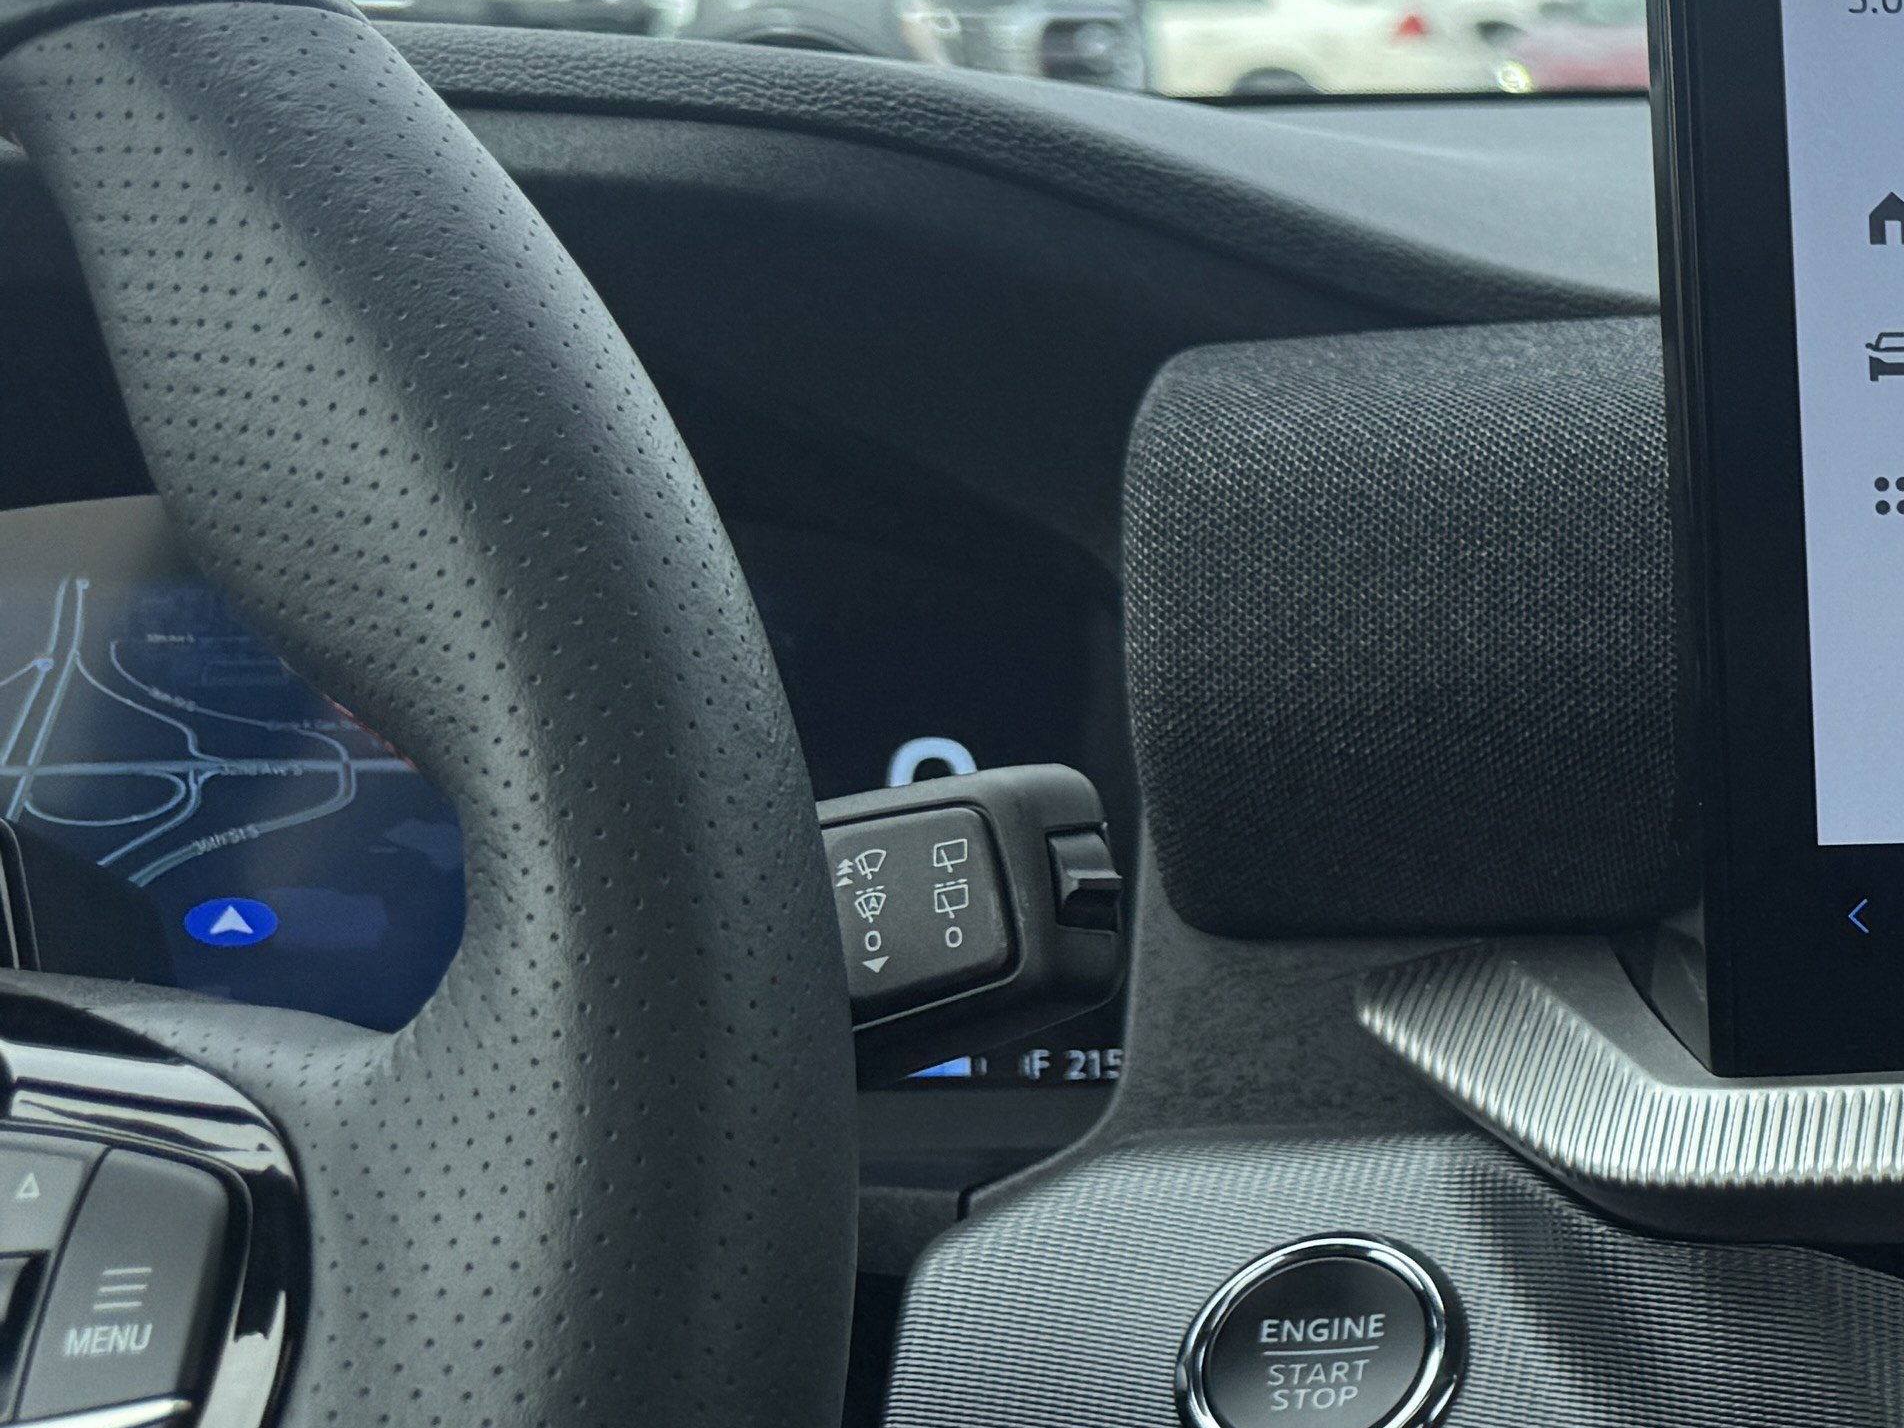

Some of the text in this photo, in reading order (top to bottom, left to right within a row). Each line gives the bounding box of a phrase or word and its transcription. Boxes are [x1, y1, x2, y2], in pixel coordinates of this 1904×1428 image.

[64, 1323, 153, 1357] MENU
[1259, 1313, 1387, 1344] ENGINE
[1266, 1358, 1371, 1387] START
[1269, 1385, 1360, 1412] STOP
